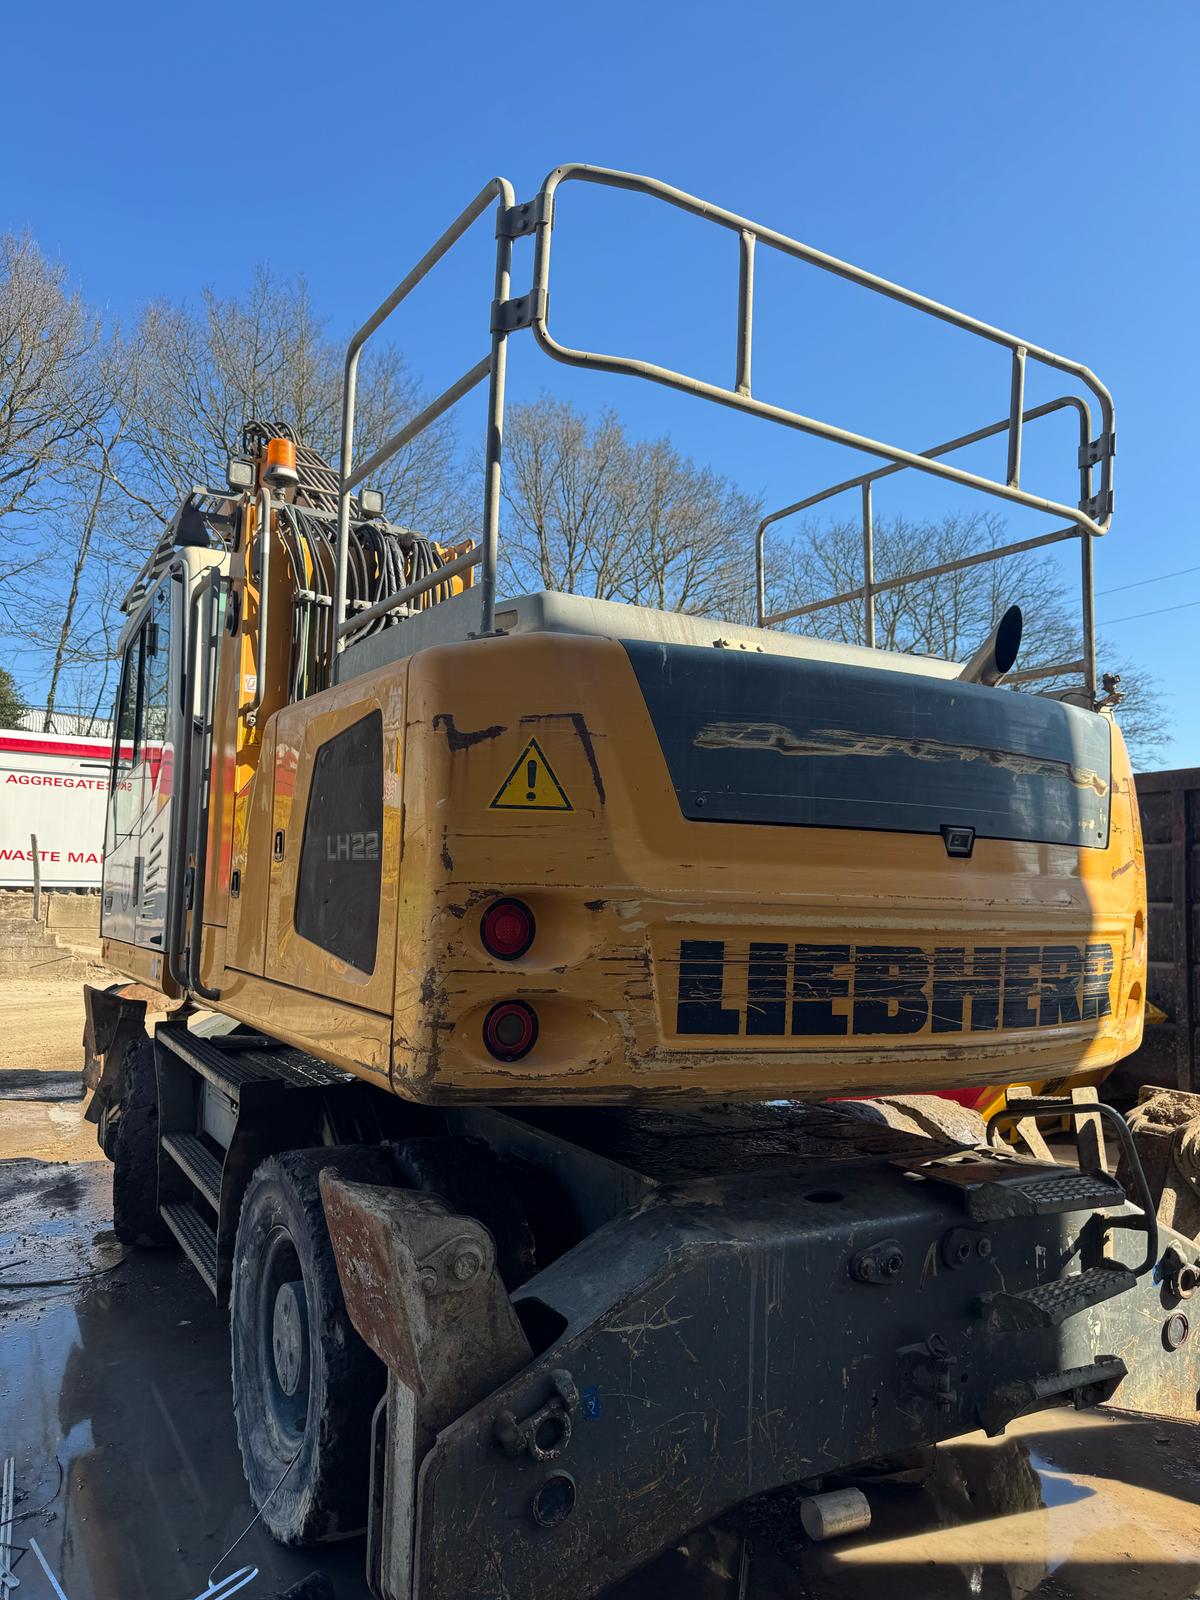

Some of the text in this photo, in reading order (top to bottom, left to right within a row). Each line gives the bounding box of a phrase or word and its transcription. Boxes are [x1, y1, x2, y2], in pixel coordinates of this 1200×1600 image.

[68, 852, 104, 864] MA
[327, 831, 379, 861] LH22
[676, 939, 1113, 1035] LIEBHERR
